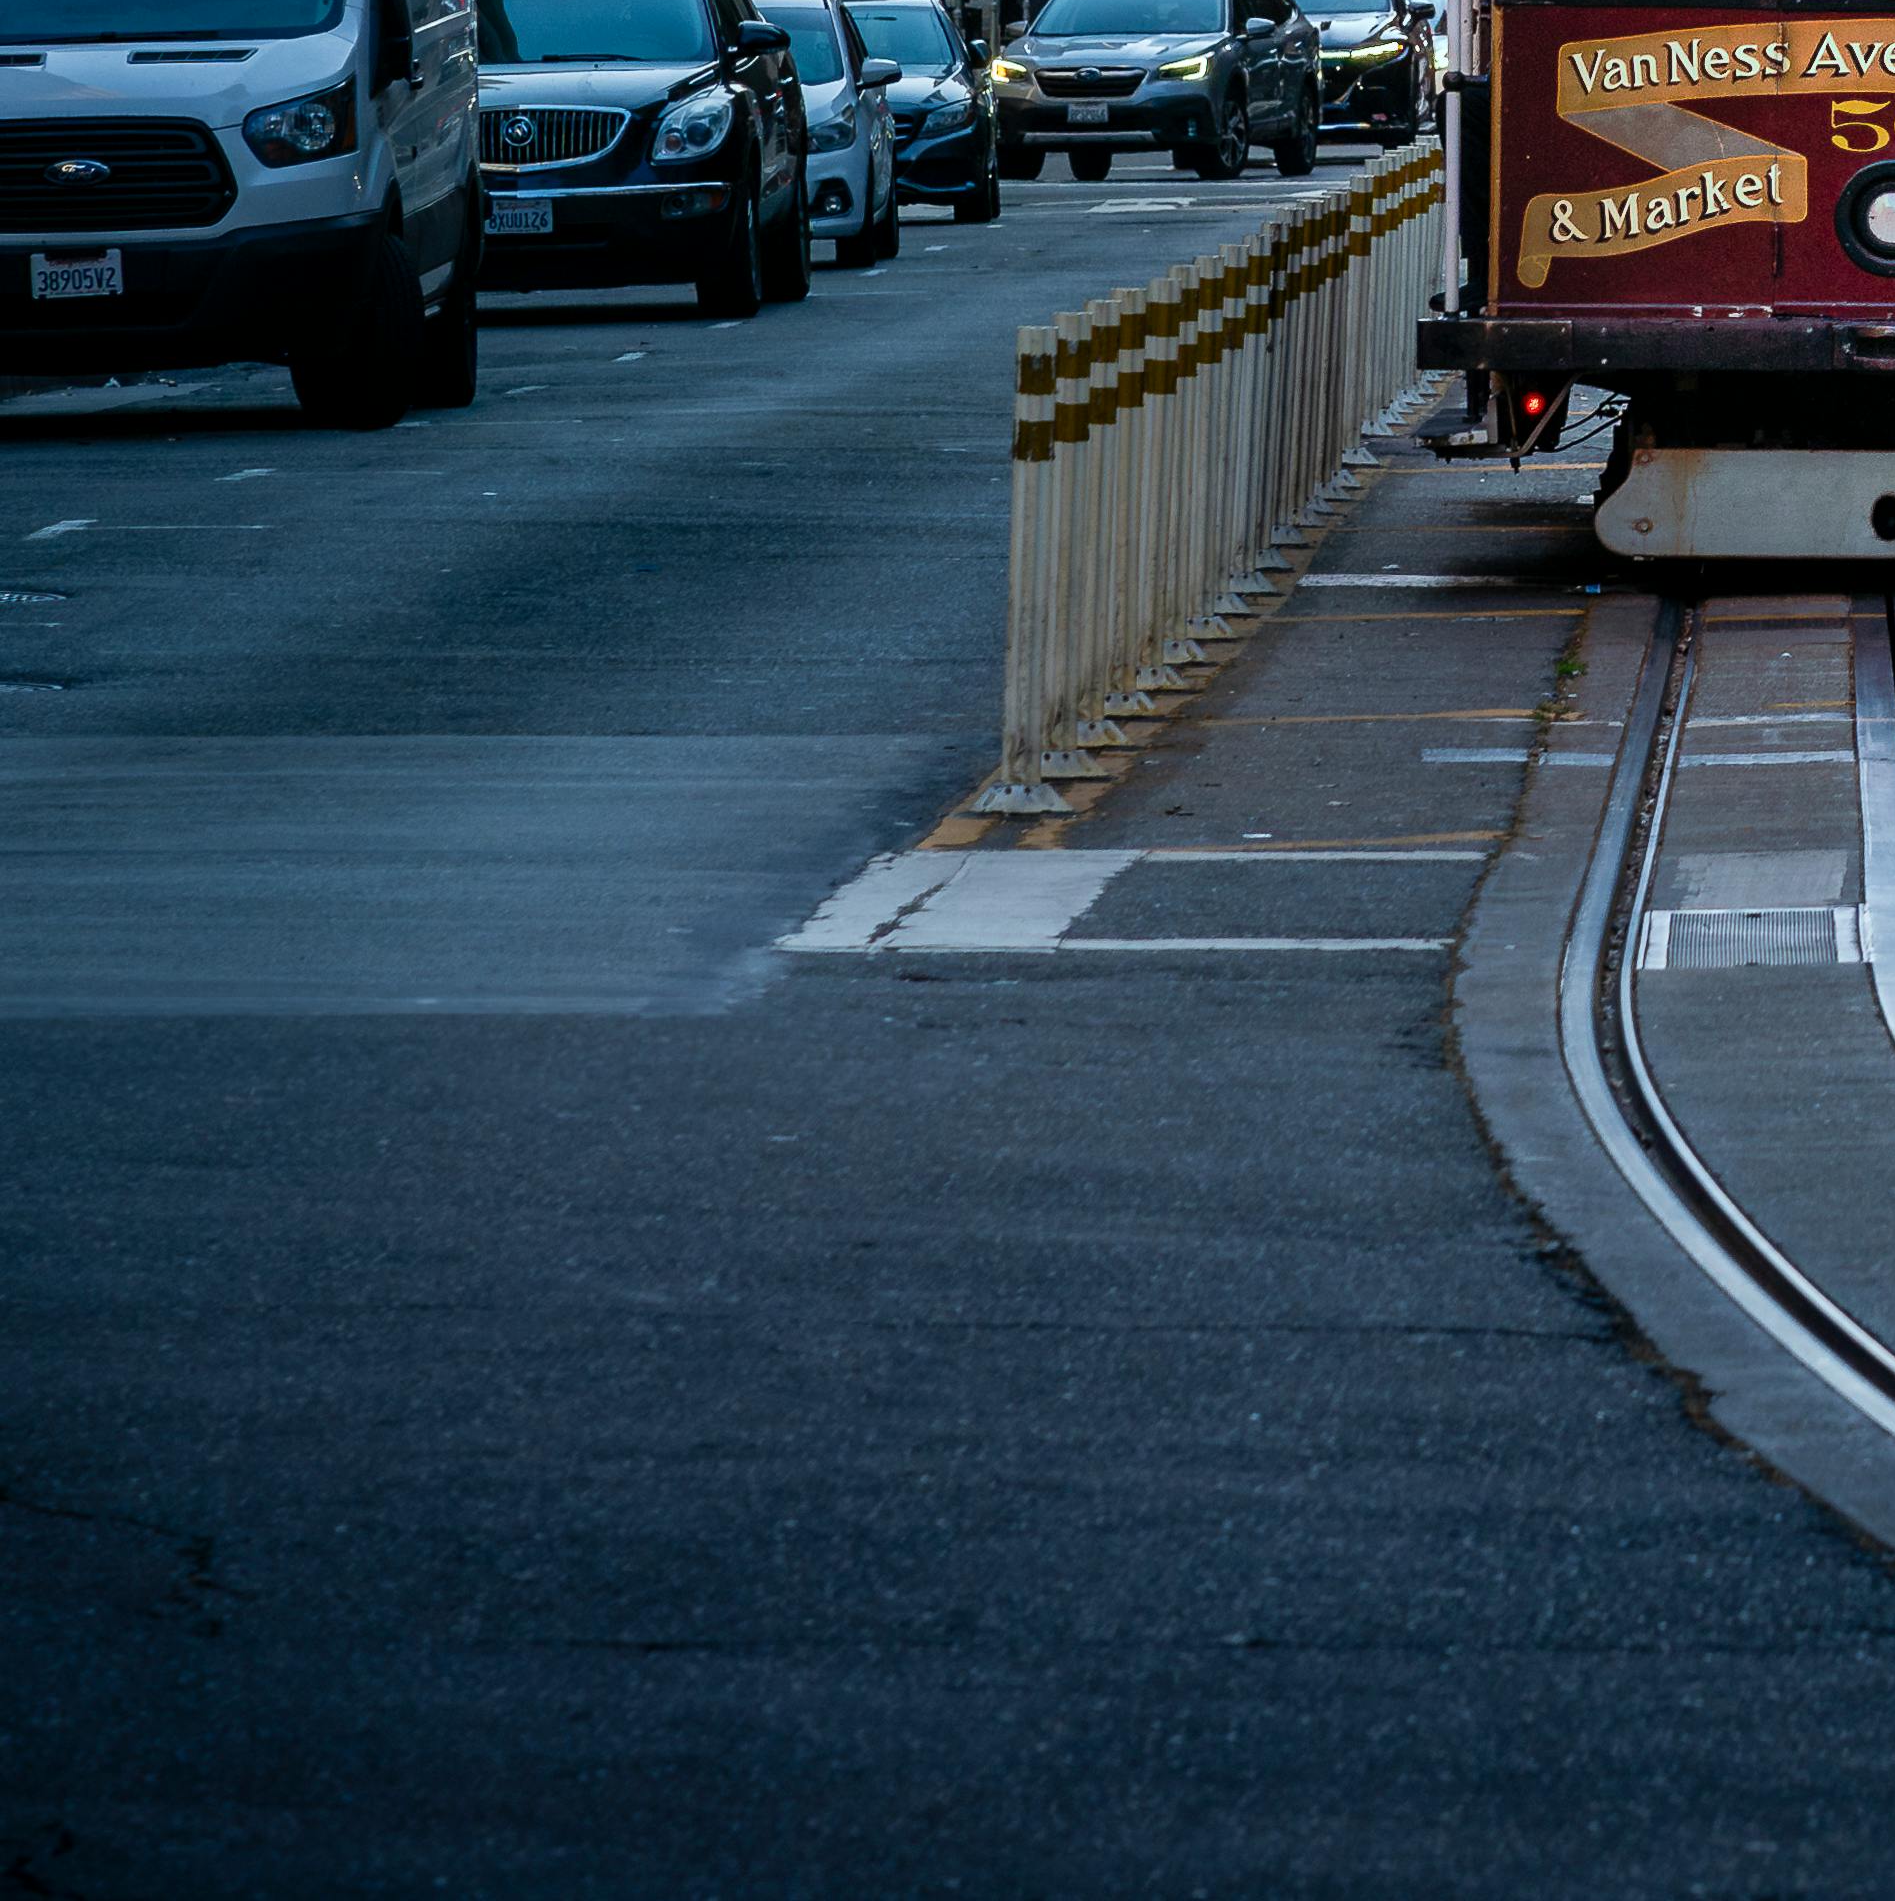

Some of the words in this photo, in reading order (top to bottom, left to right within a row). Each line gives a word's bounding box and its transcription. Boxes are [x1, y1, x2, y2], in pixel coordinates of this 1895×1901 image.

[1550, 198, 1589, 243] &
[1596, 163, 1784, 242] Market
[37, 267, 116, 292] 38905V2
